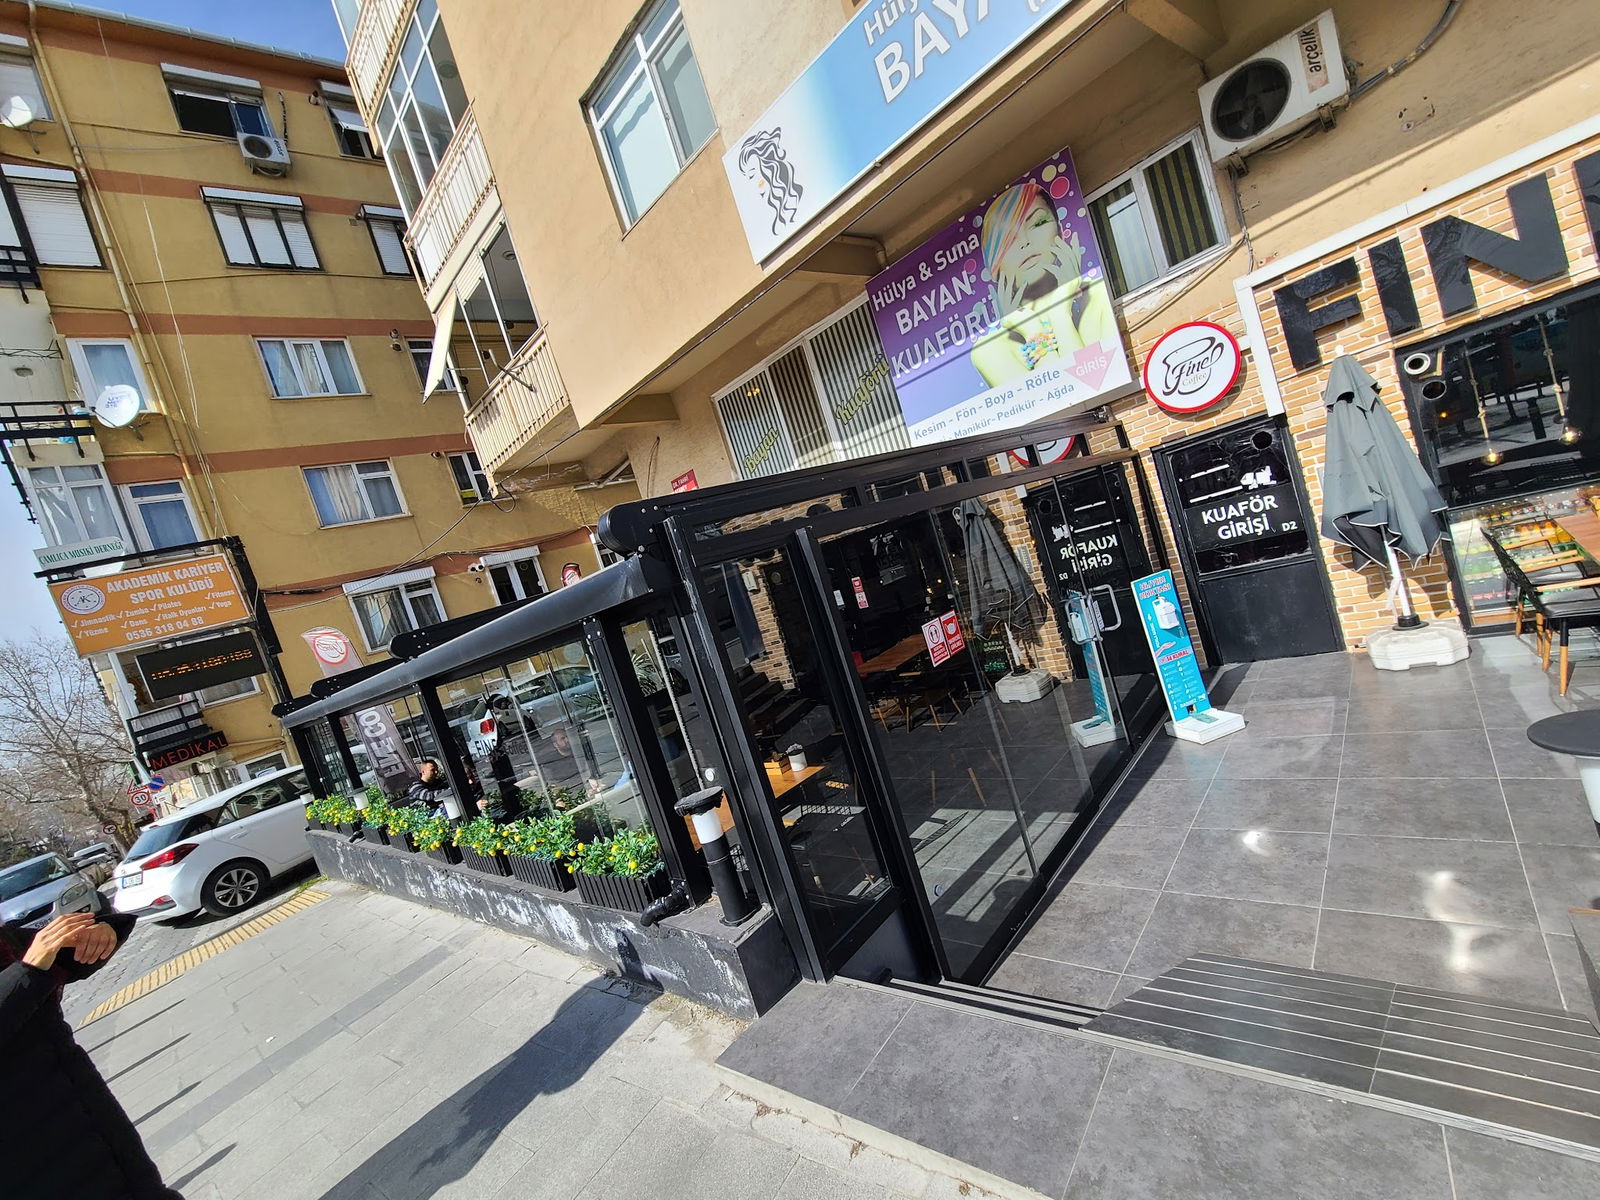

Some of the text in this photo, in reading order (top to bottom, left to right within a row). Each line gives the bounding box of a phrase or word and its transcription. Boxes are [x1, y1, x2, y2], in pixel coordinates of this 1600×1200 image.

[863, 0, 919, 46] Hül
[874, 0, 989, 104] BAY
[1299, 27, 1323, 73] arçelik
[872, 233, 980, 312] Hülya & Suna
[895, 270, 974, 335] BAYAN
[891, 295, 1001, 379] KUAFÖRÜ
[1075, 355, 1107, 377] GİRİŞ
[1182, 372, 1207, 386] Coffee
[914, 420, 947, 440] Kesim
[955, 408, 977, 421] Fön
[985, 390, 1014, 409] Boya
[1025, 369, 1061, 391] Röfle
[997, 399, 1036, 421] Pedikür
[1047, 383, 1075, 400] Ağda
[1201, 495, 1278, 525] KUAFÖR
[1217, 513, 1270, 540] GİRİŞİ
[1281, 521, 1298, 532] D2
[94, 540, 124, 554] DERNEĞİ
[106, 561, 225, 594] AKADEMİK KARİYER
[129, 576, 215, 605] SPOR KULÜBÜ
[125, 628, 153, 642] 0536
[154, 622, 174, 637] 318
[175, 619, 189, 632] 04
[151, 735, 227, 770] MEDİKAL
[134, 794, 146, 803] 30
